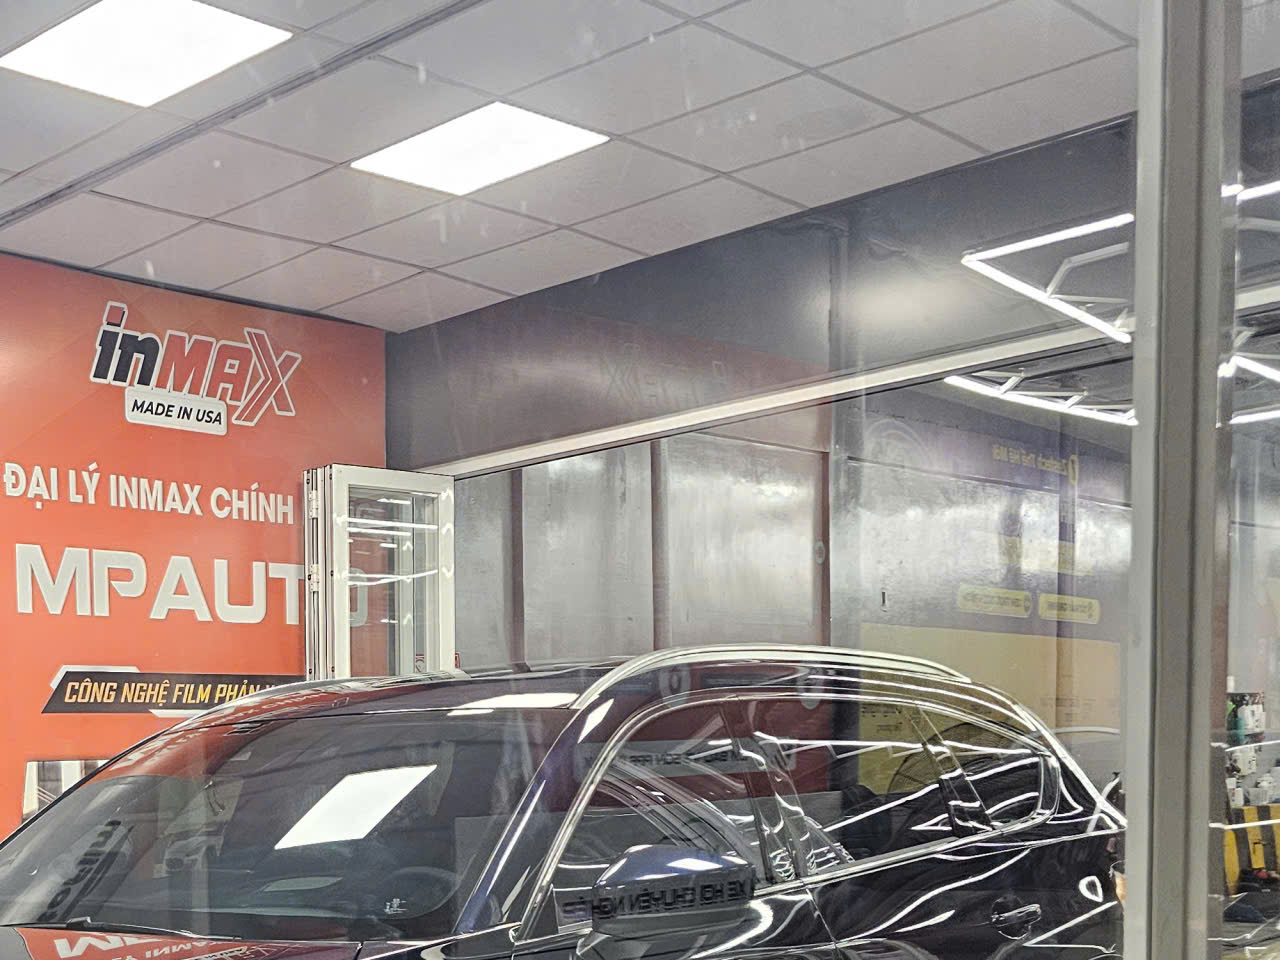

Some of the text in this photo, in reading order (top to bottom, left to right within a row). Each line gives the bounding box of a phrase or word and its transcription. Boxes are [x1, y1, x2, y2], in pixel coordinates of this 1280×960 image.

[131, 399, 223, 426] MADE IN USA
[3, 462, 295, 525] ĐẠI LÝ INMAX CHÍNH
[64, 677, 117, 704] CÔNG
[120, 678, 170, 707] NGHỆ
[172, 683, 213, 704] FILM
